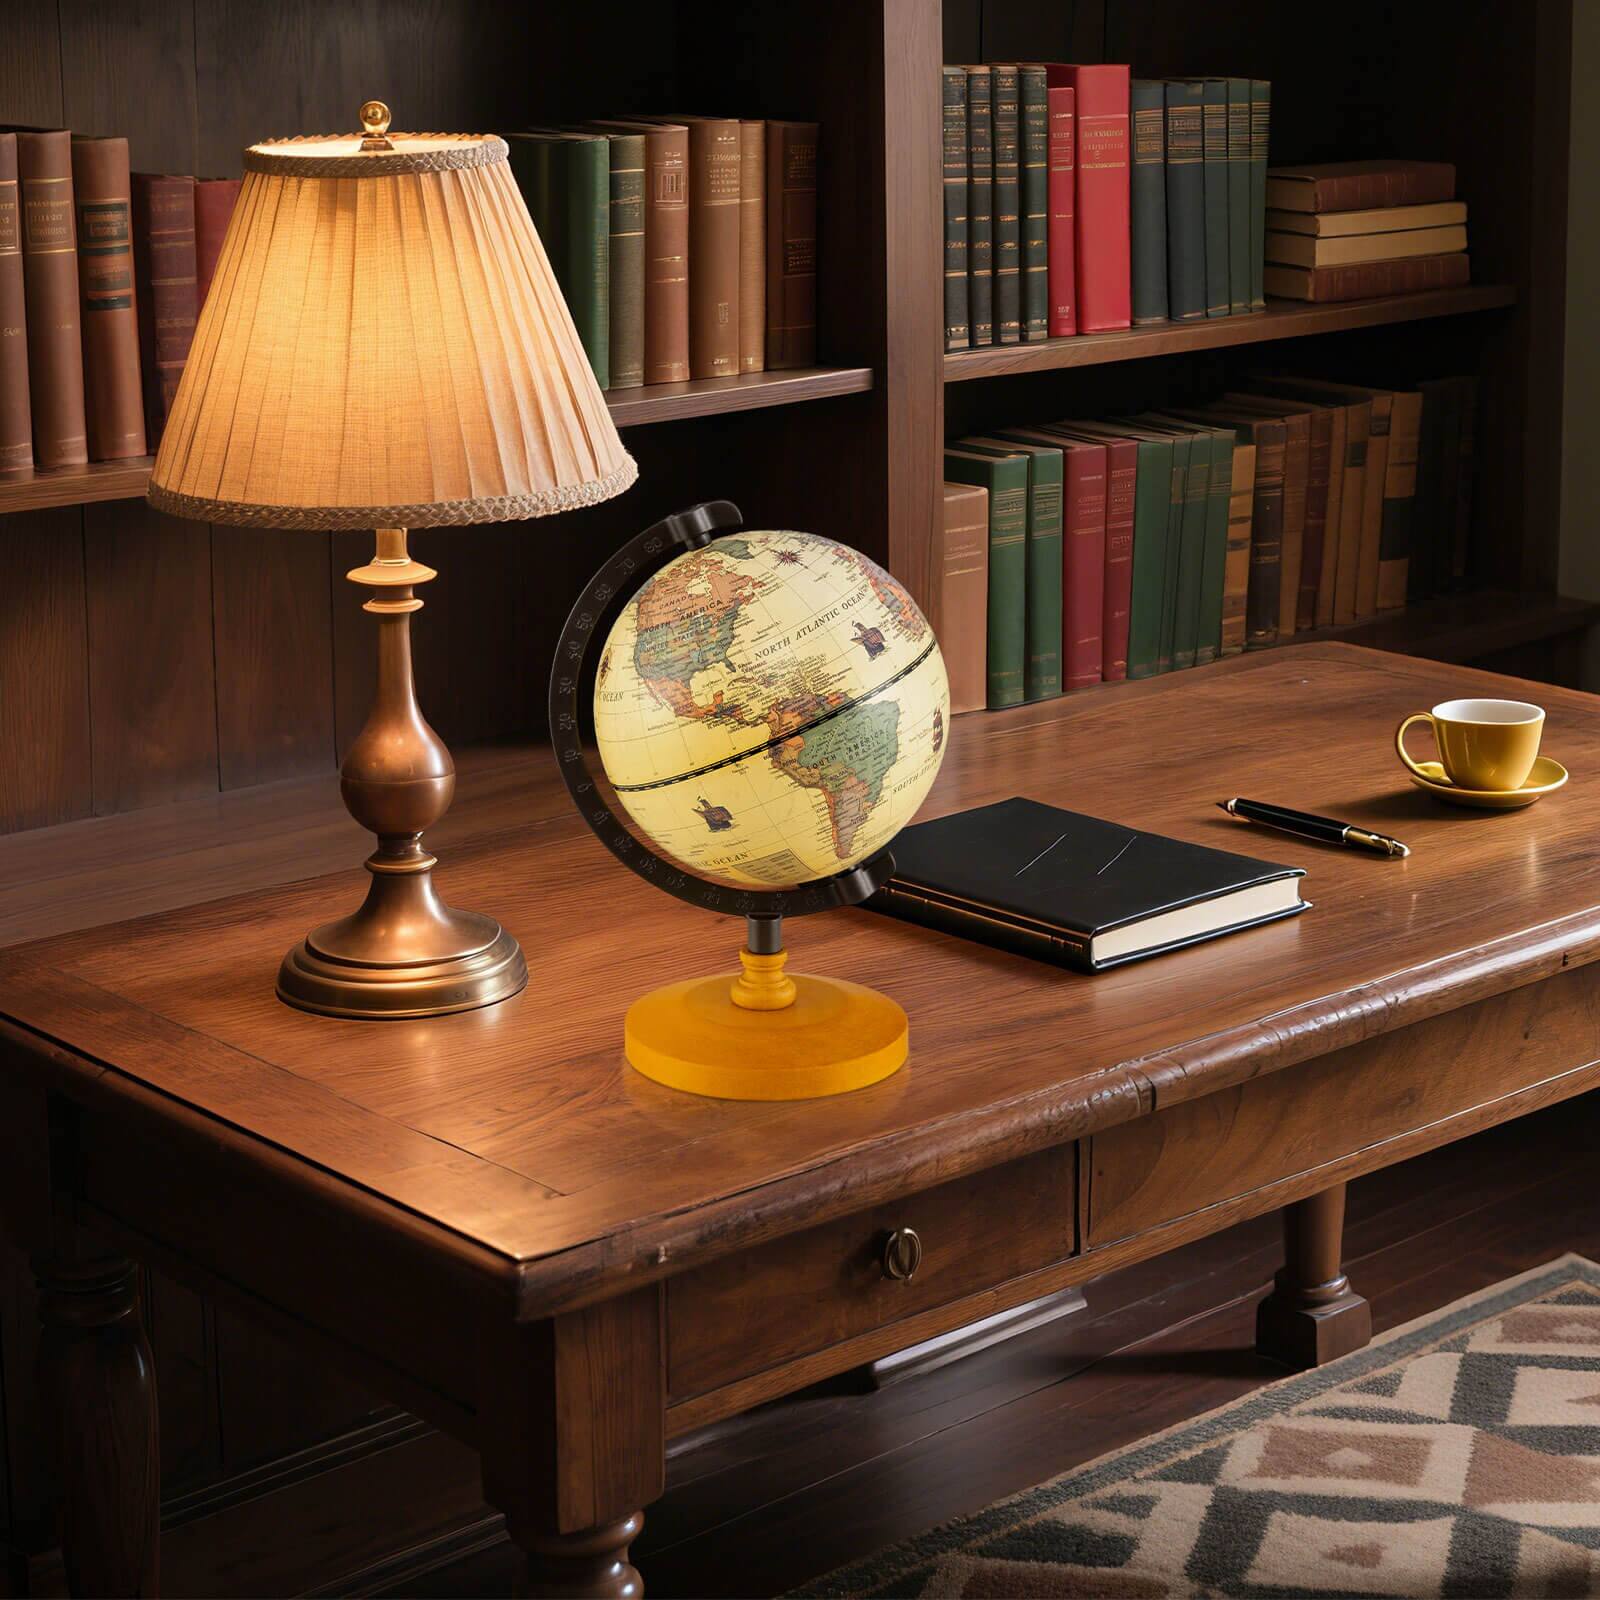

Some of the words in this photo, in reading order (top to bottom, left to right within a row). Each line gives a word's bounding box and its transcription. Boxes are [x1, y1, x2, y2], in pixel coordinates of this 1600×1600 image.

[659, 593, 693, 610] CANADA
[680, 599, 723, 622] AMERICA
[754, 636, 791, 660] NORTH
[795, 607, 841, 640] ATLANTIC
[841, 588, 867, 610] OCEAN
[602, 691, 624, 703] OCEAN
[806, 754, 837, 772] SOUTH
[846, 729, 884, 753] AMERICA
